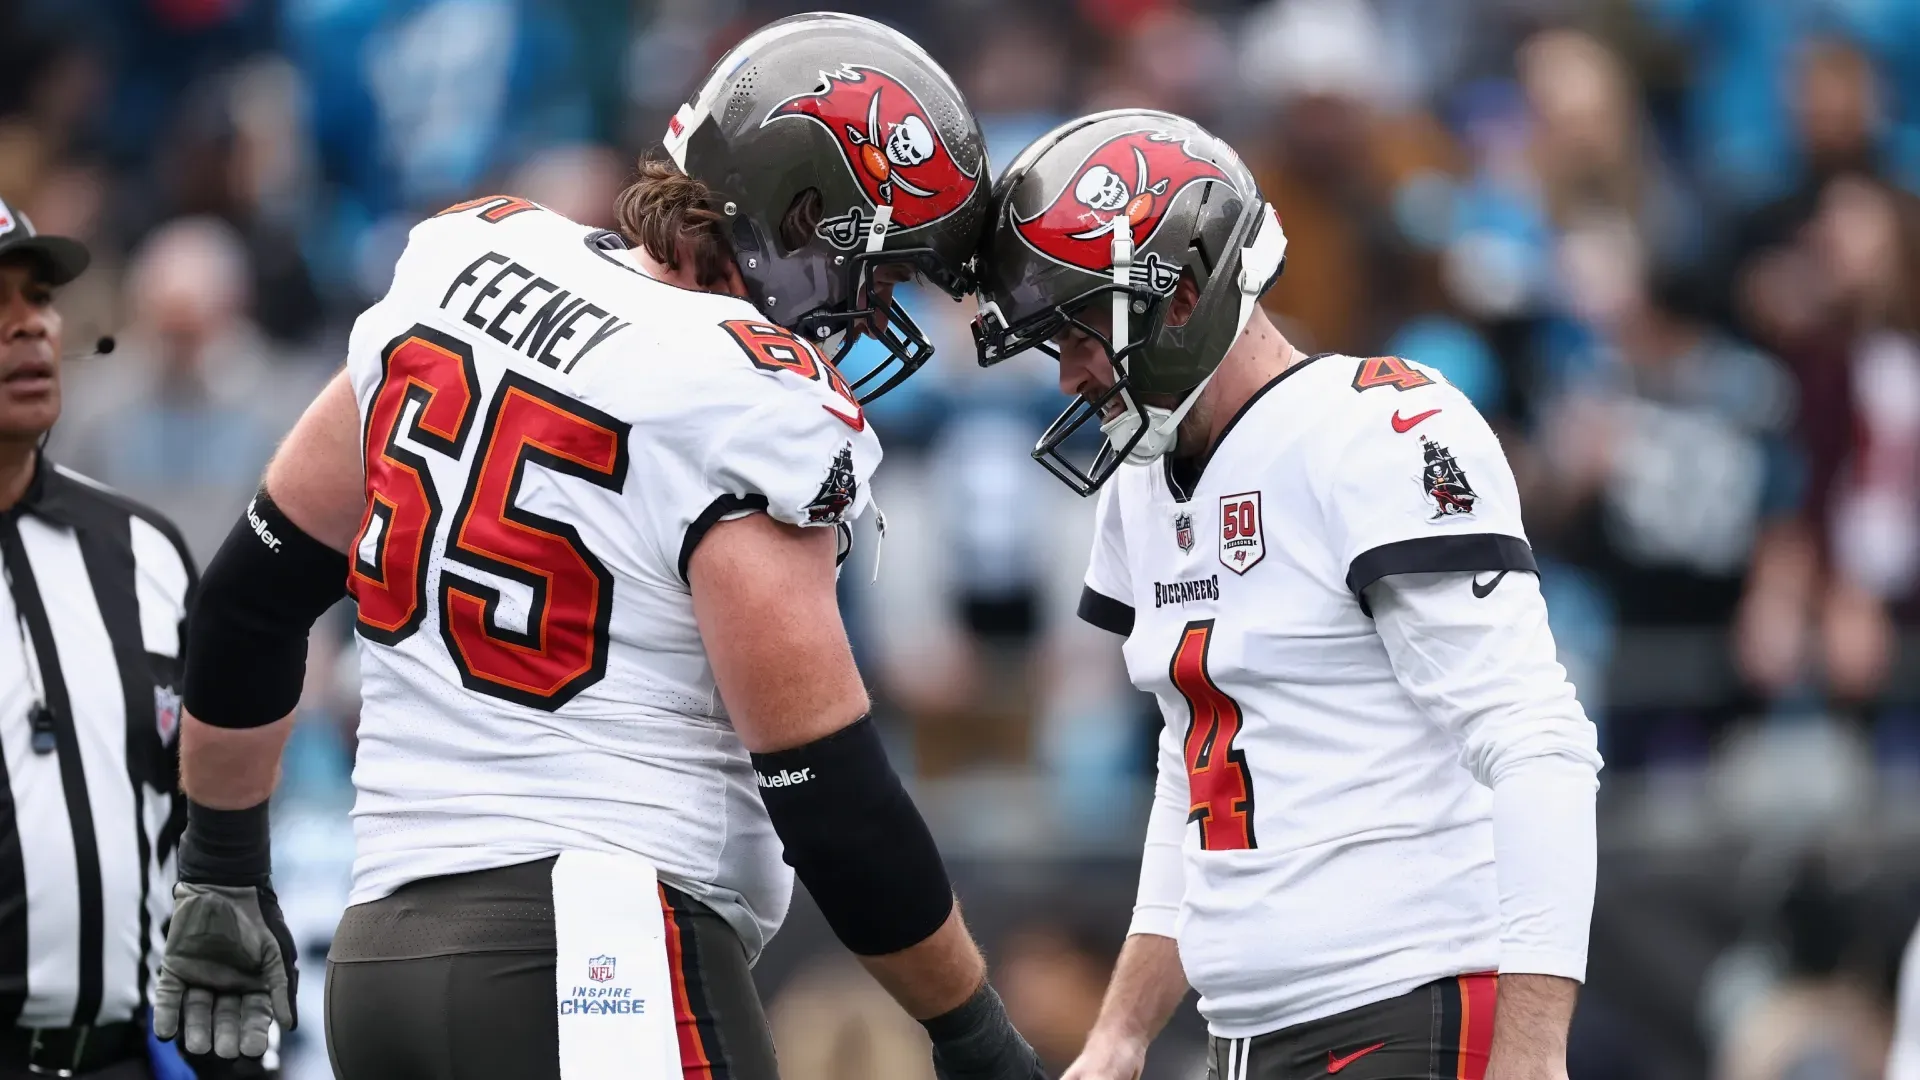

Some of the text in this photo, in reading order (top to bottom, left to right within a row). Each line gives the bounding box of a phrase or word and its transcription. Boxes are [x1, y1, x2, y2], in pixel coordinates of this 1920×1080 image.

[439, 251, 632, 375] FEENEY
[1351, 356, 1436, 393] 4
[347, 323, 633, 712] 65
[1223, 501, 1256, 540] 50
[1154, 574, 1219, 608] BUCCANEERS
[1169, 618, 1258, 850] 4
[591, 967, 613, 979] NFL
[560, 999, 645, 1015] CHANGE
[572, 986, 632, 998] INSPIRE
